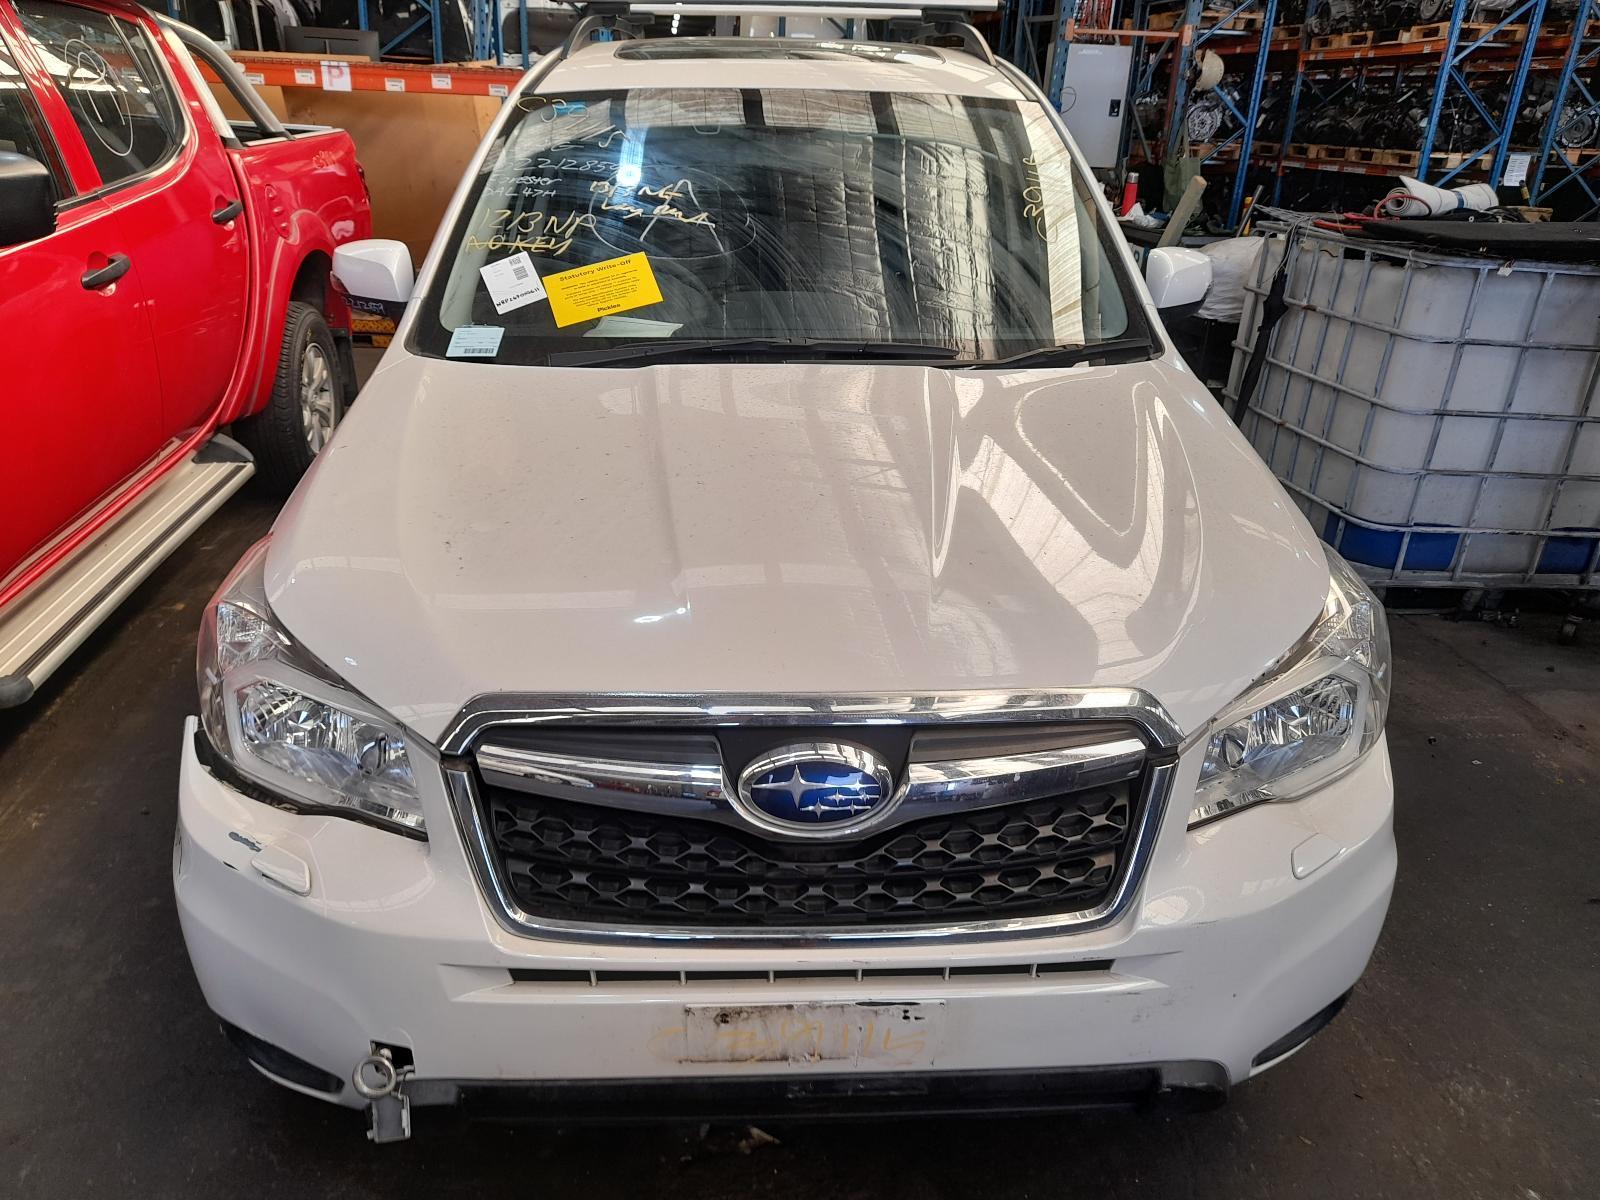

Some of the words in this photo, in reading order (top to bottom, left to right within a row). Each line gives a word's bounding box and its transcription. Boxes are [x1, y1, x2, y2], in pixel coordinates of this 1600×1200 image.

[327, 65, 344, 87] P
[559, 268, 596, 282] Statutory
[596, 259, 631, 272] Write-Off
[596, 303, 621, 313] Pickles
